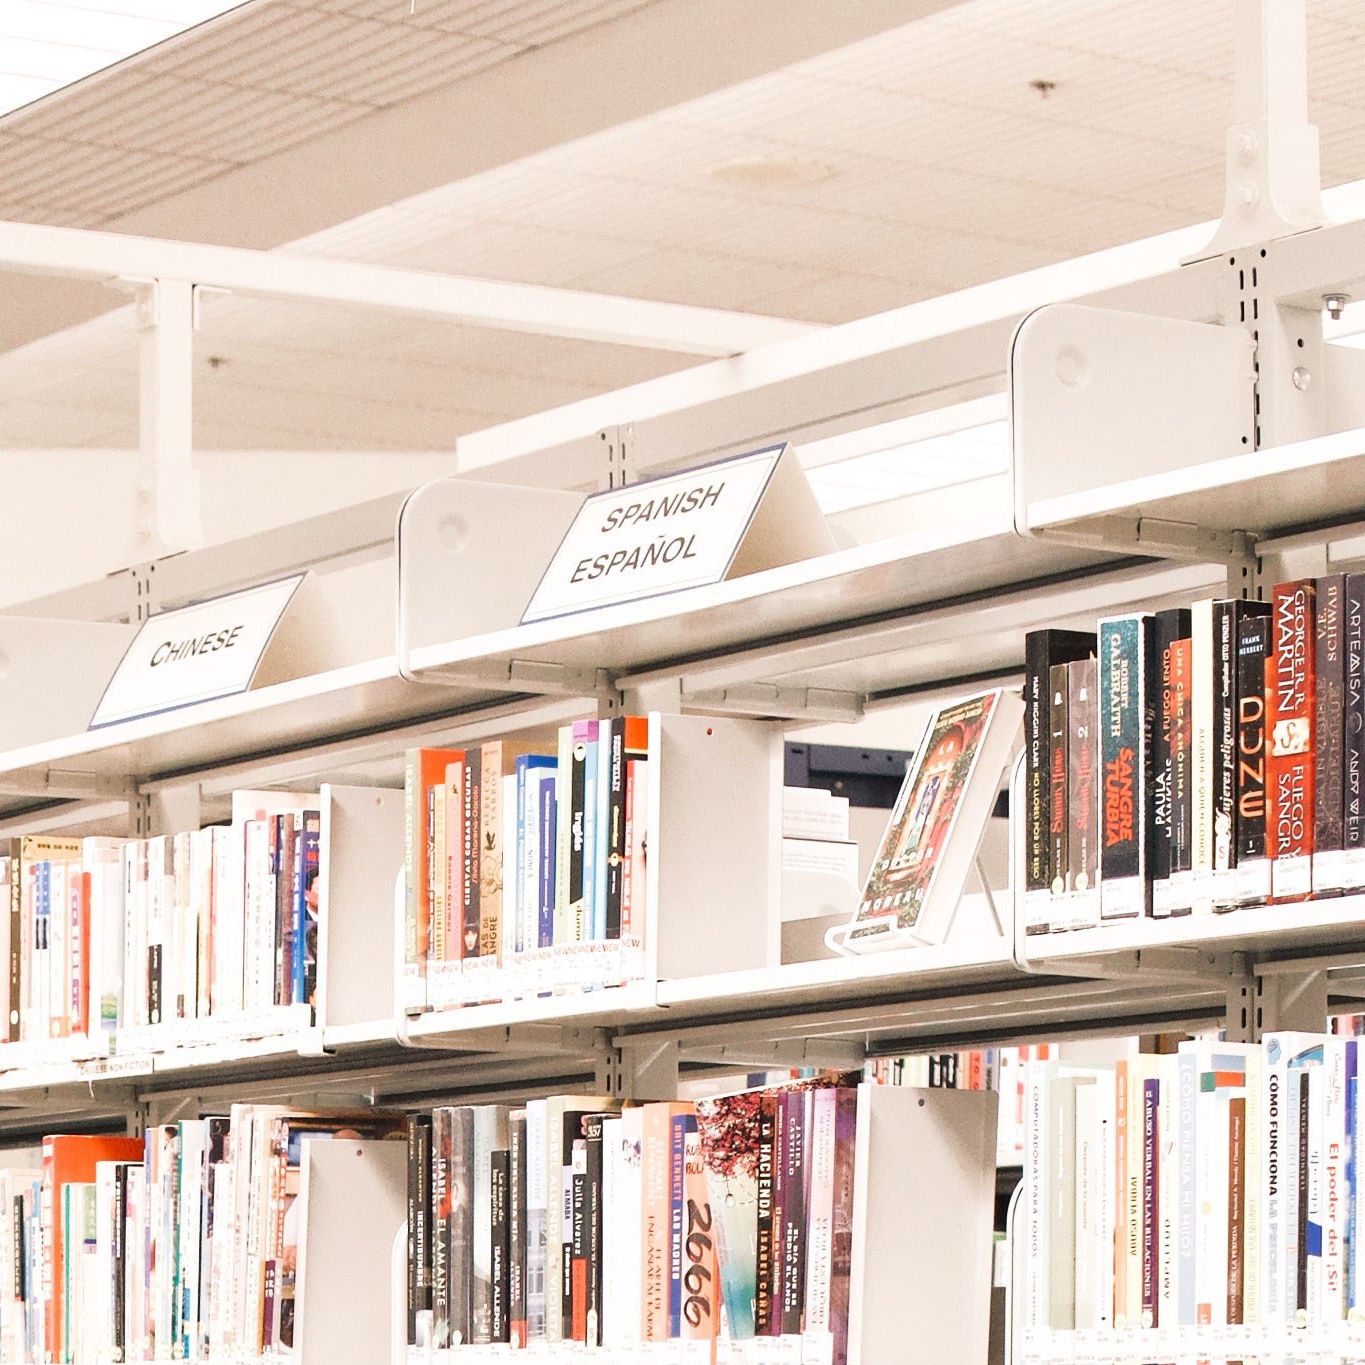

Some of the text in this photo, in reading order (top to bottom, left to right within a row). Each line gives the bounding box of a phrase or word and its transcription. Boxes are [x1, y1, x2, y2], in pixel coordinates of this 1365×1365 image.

[600, 482, 724, 534] SPANISH
[570, 534, 698, 584] ESPAÑOL
[150, 626, 243, 667] CHINESE
[1277, 594, 1295, 712] MARTIN
[1294, 589, 1305, 674] GEORGE
[1111, 633, 1122, 738] GALBRAITH
[1105, 760, 1121, 848] TURBIA
[1119, 747, 1134, 842] SANGRE
[1155, 771, 1166, 825] PAULA
[1238, 695, 1264, 819] DUNE
[759, 1123, 772, 1219] LA HACIENDA
[1269, 1074, 1279, 1196] CÓMO FUNCIONA
[437, 1158, 446, 1306] ISABEL AMANTE
[549, 1116, 557, 1342] ISABEL ALLENDE VIOLETA
[684, 1198, 714, 1329] 2666
